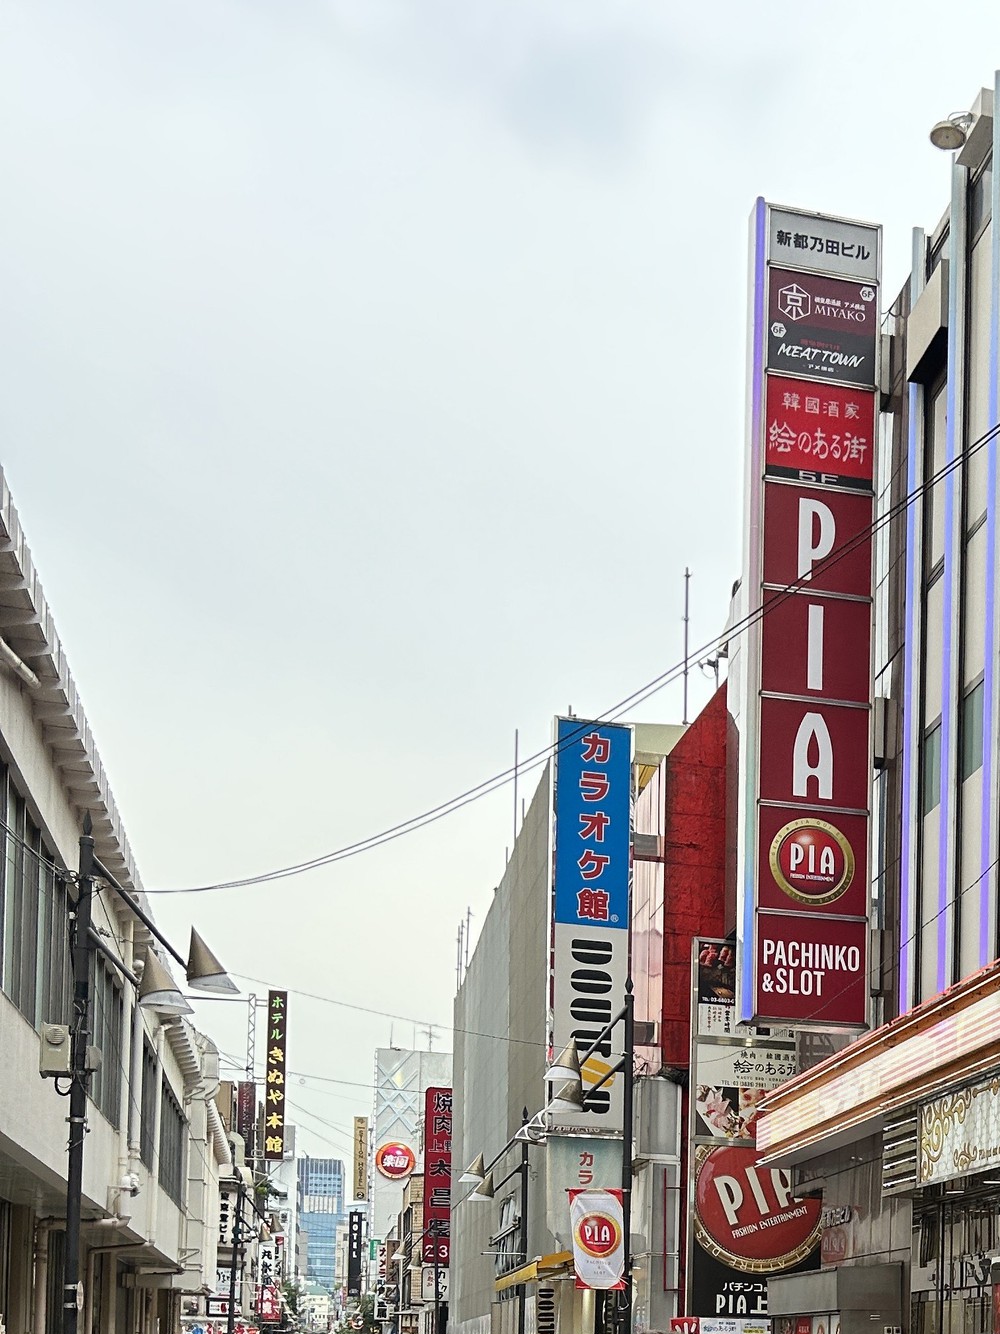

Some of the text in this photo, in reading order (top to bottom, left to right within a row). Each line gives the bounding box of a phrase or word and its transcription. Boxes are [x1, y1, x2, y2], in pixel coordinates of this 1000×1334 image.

[776, 230, 871, 260] 新都乃田ビル
[861, 290, 873, 298] 6F
[814, 305, 866, 323] MIYAKO
[772, 326, 784, 334] 6F
[781, 392, 860, 420] 韓國酒家
[769, 418, 867, 464] 絵のある街
[798, 470, 839, 484] 5F
[577, 732, 611, 923] カラオケ館
[789, 842, 835, 875] PIA
[763, 939, 860, 973] PACHINKO
[584, 1225, 611, 1242] PIA
[731, 1206, 808, 1239] FASHION ENTERTAINMENT
[715, 1294, 747, 1314] PIA
